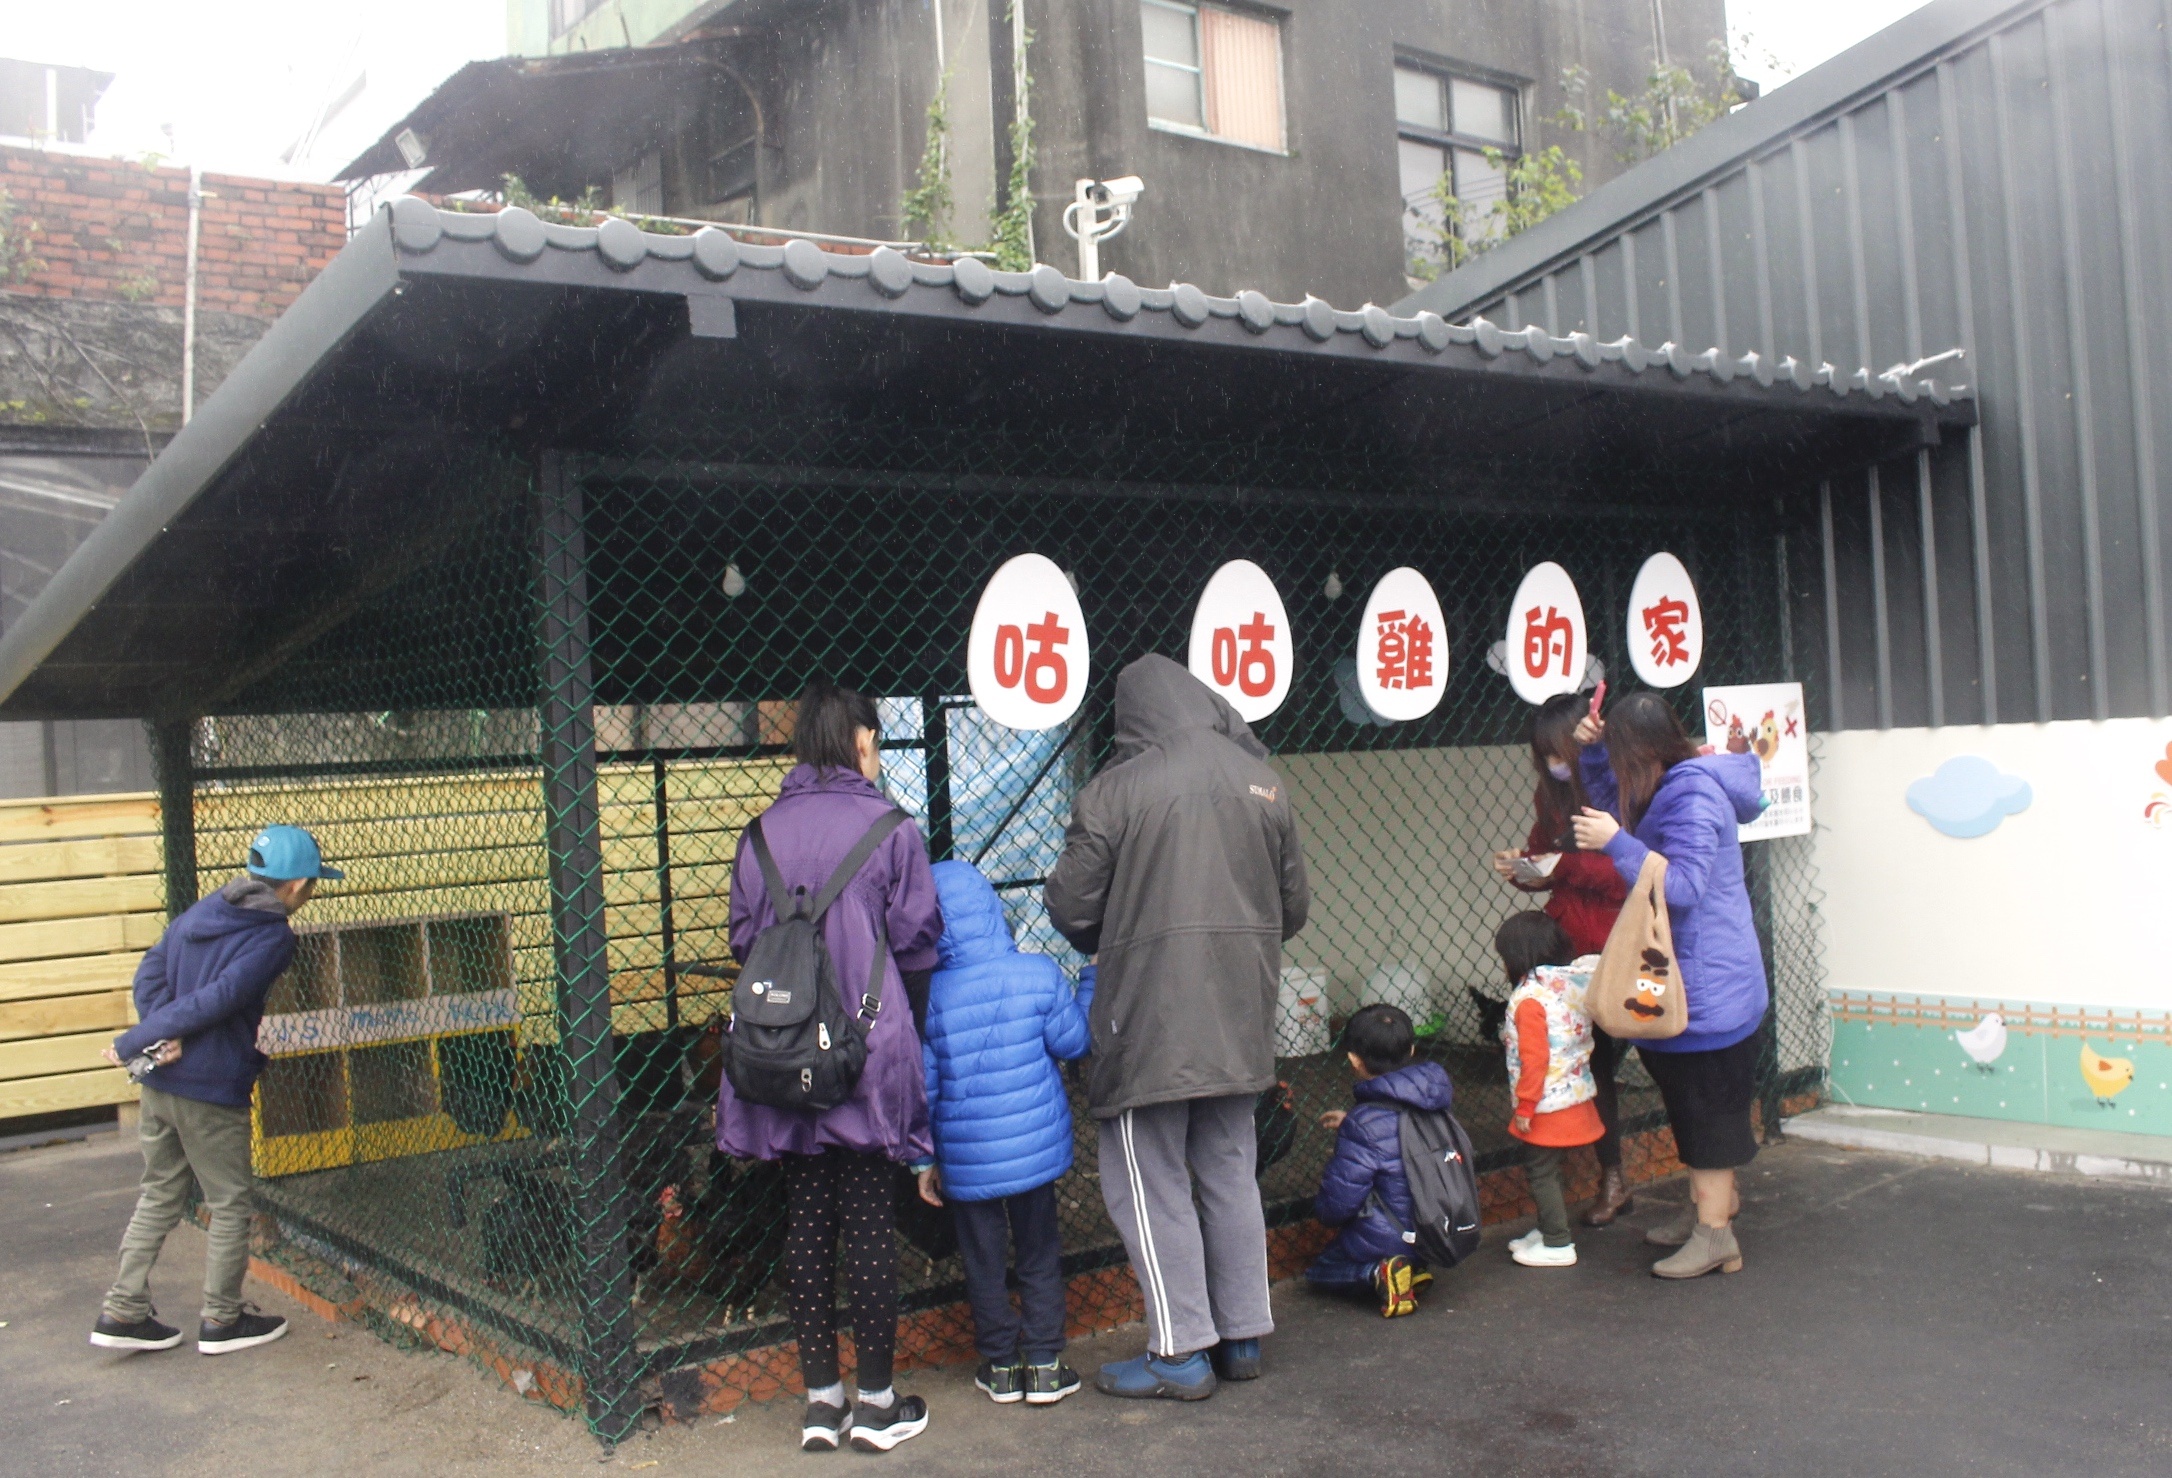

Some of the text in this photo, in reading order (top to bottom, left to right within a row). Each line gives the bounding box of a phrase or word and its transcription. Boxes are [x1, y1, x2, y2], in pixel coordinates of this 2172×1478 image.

[993, 595, 1690, 705] 咕 咕 雞 的 家
